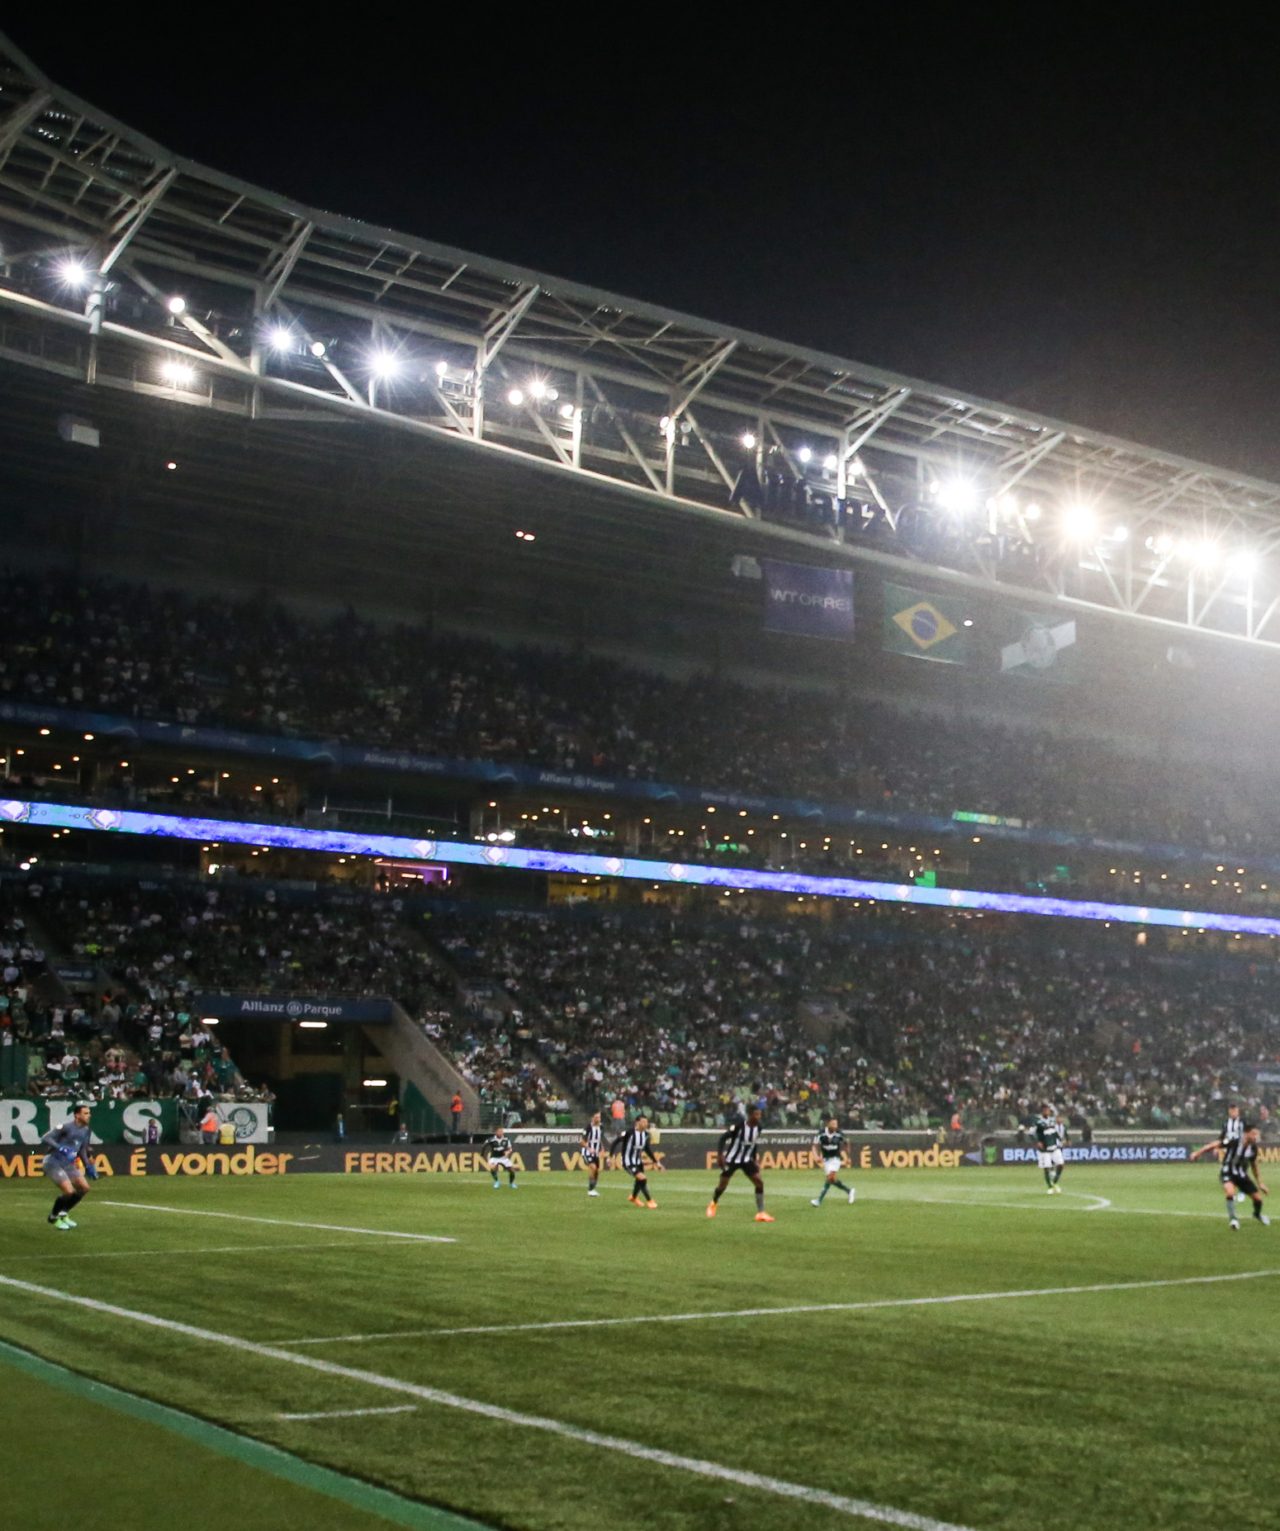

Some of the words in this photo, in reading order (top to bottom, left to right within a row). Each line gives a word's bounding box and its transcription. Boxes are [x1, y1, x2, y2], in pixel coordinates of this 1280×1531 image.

[240, 1000, 285, 1014] Allianz
[303, 1003, 342, 1017] Parque
[130, 1147, 147, 1177] É
[160, 1145, 293, 1176] vonder
[860, 1147, 873, 1168] É
[880, 1143, 964, 1168] vonder
[1150, 1147, 1187, 1160] 2022
